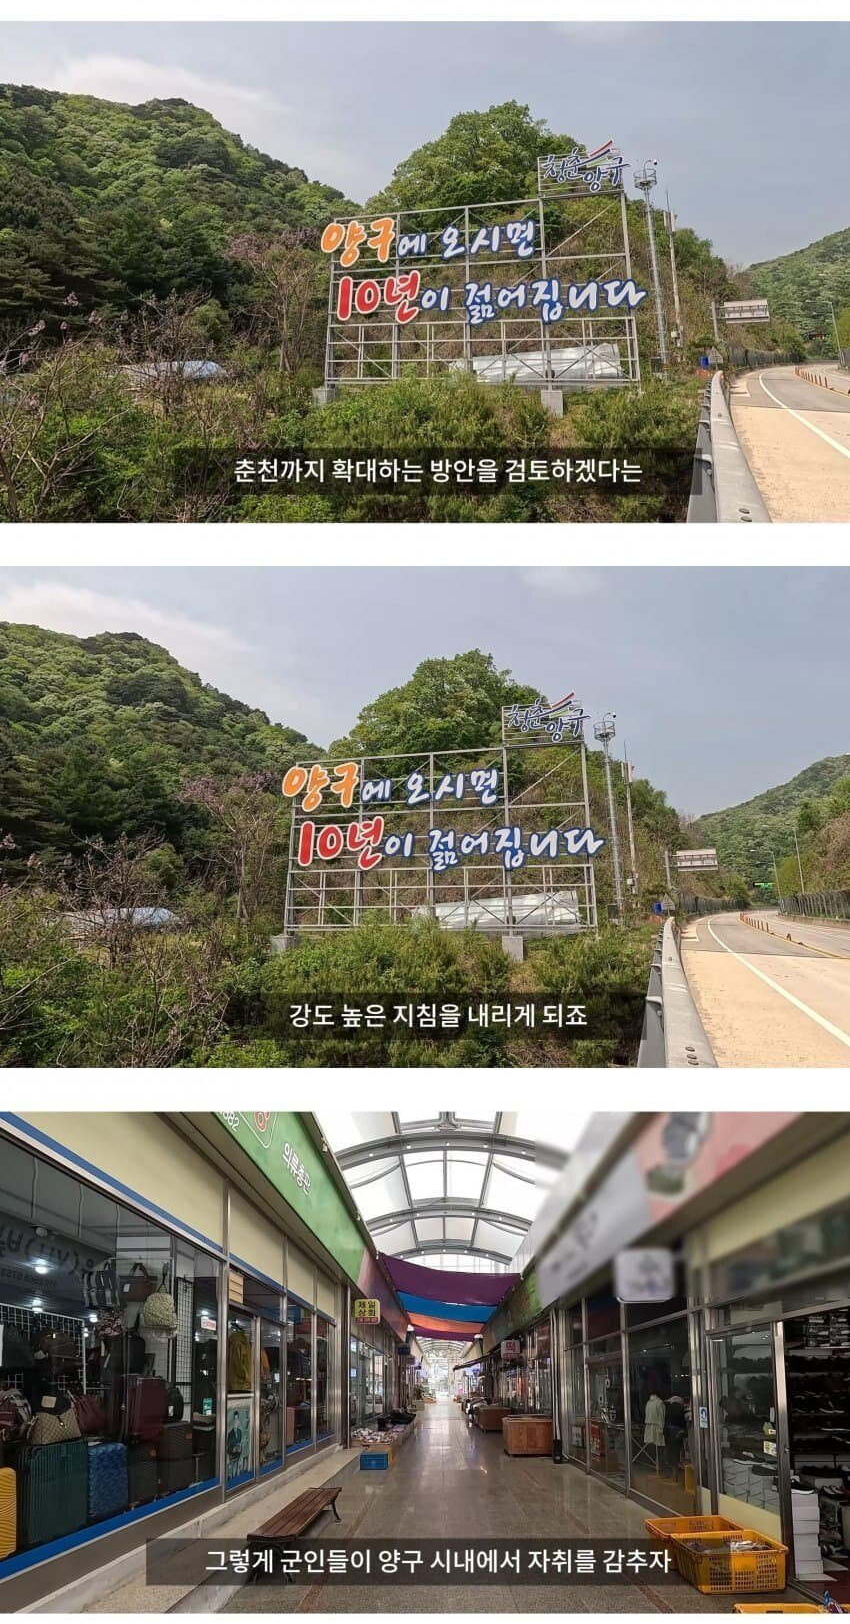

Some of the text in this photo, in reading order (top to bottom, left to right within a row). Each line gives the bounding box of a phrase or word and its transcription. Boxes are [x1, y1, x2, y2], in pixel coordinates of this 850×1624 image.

[542, 147, 632, 193] 청춘 양구
[320, 217, 537, 268] 양구에 오시면
[336, 271, 648, 326] 10년이 젊어집니다
[507, 697, 592, 742] 청춘 양구
[282, 762, 501, 812] 양구에 오시면
[297, 816, 607, 872] 10년이 젊어집니다
[281, 1142, 311, 1195] 의류총판
[357, 1301, 376, 1309] 제일
[357, 1309, 376, 1317] 상회
